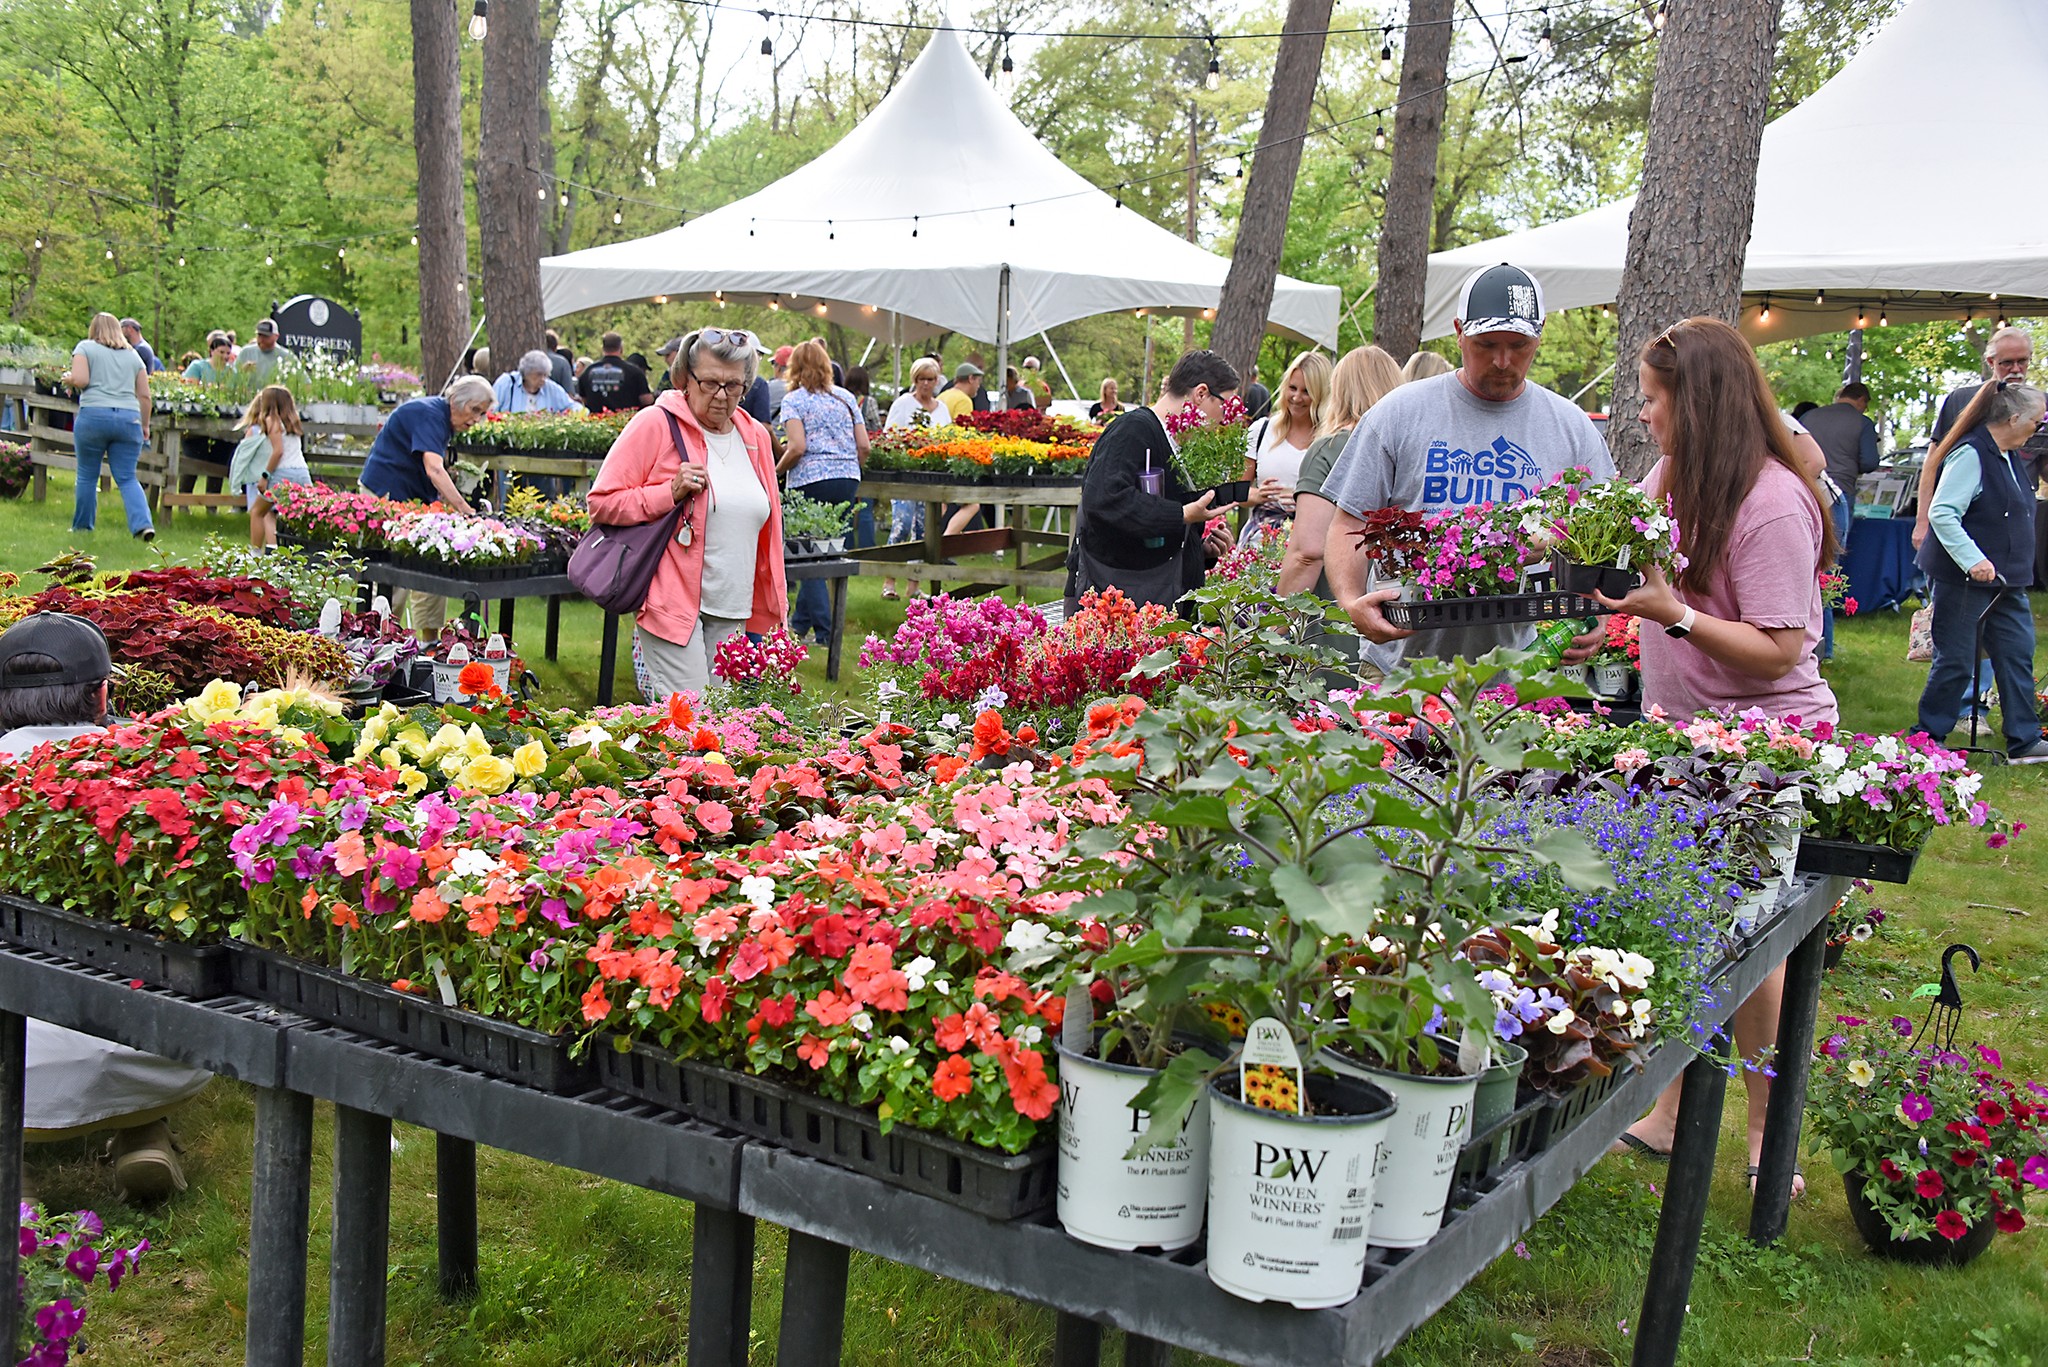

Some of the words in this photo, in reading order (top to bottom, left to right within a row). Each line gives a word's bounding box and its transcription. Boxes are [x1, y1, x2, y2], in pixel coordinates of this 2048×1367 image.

[285, 334, 352, 350] EVERGREEN
[1519, 463, 1541, 480] for
[1422, 475, 1539, 506] BUILD
[1256, 1026, 1284, 1041] PW
[1253, 1140, 1330, 1184] PW
[1256, 1180, 1318, 1200] PROVEN
[1249, 1193, 1322, 1214] WINNERS
[1275, 1216, 1294, 1228] Plant
